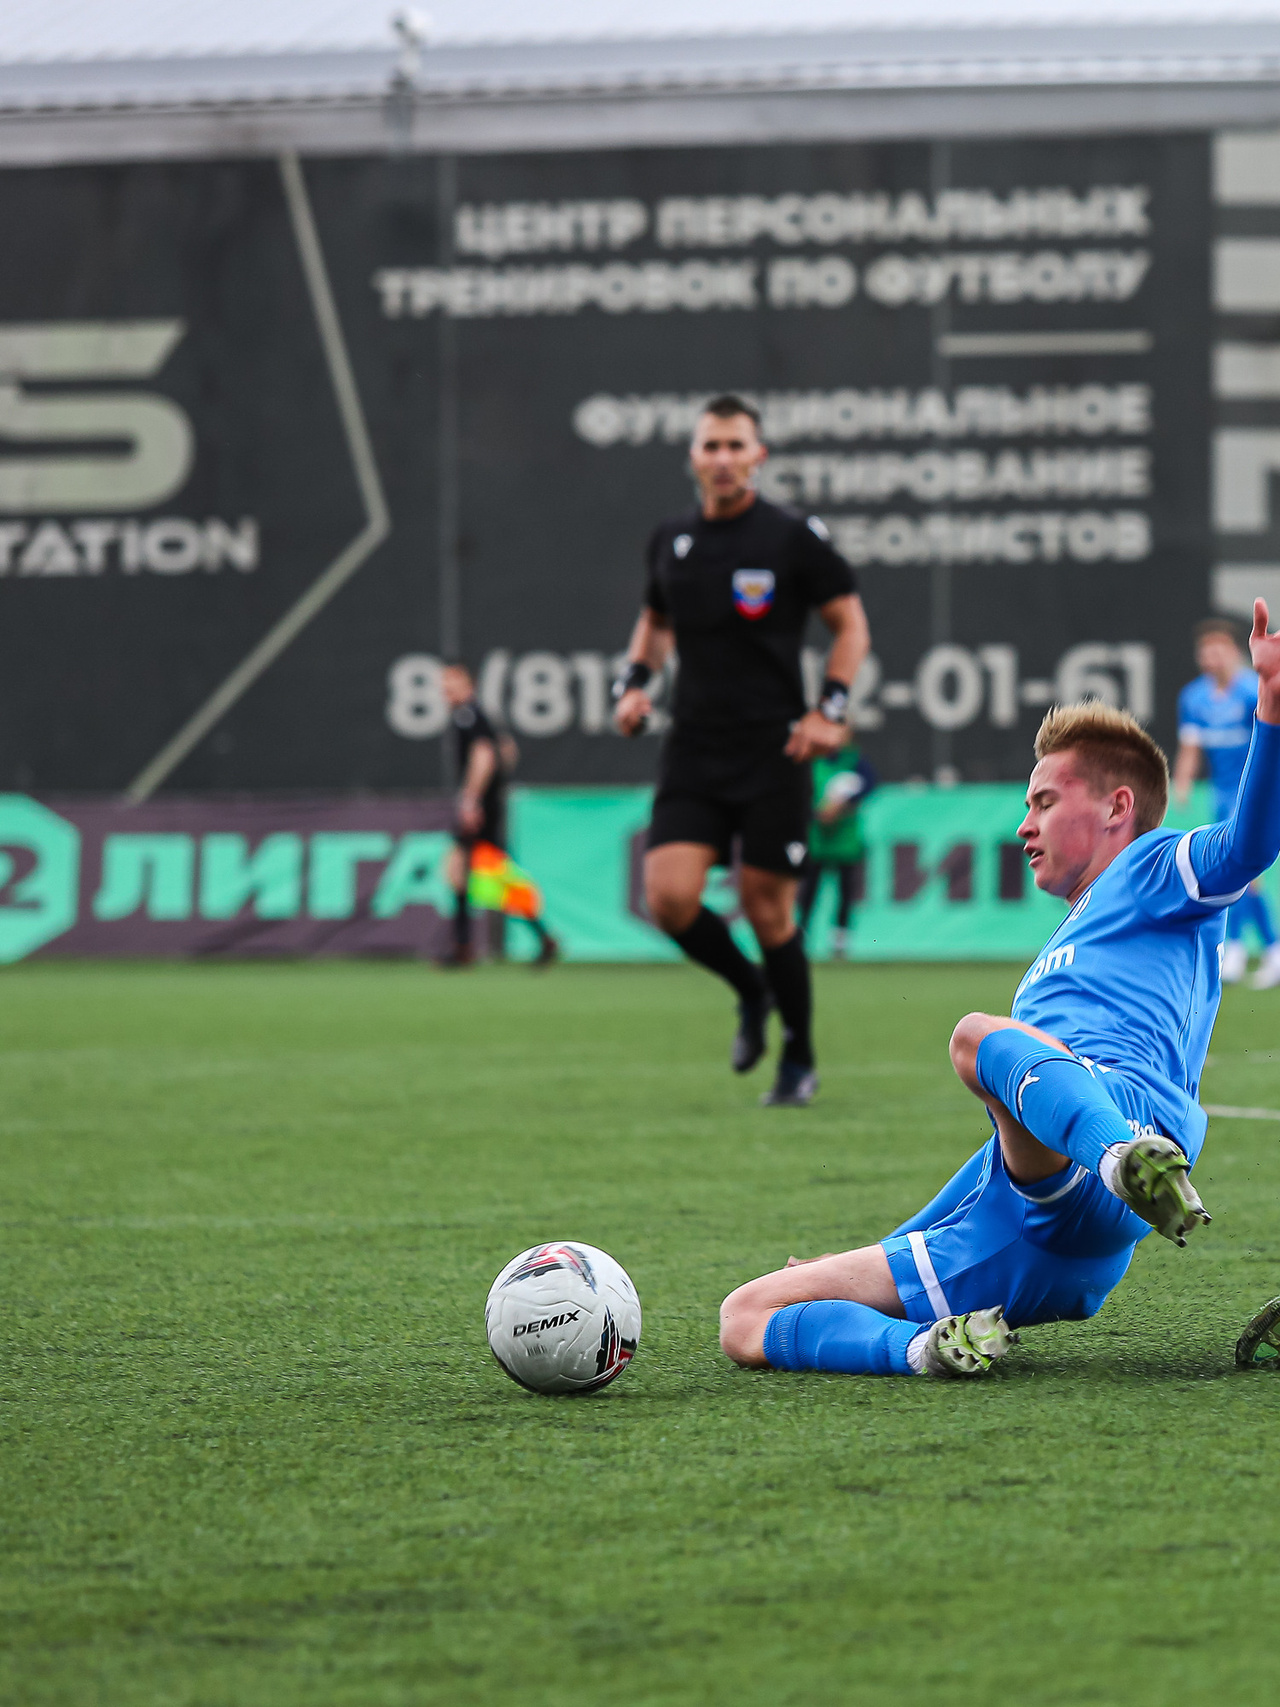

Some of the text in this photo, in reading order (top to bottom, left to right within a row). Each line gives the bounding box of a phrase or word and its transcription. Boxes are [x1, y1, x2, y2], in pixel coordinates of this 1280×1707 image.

[455, 186, 1151, 260] ЦЕНТР ПЕРСОНАЛЬНЫХ
[376, 247, 1152, 319] ТРЕНИРОВОК ПО ФУТБОЛУ
[756, 446, 1153, 502] СТИРОВАНИЕ
[0, 516, 259, 577] TATION
[825, 507, 1152, 567] БОЛИСТОВ
[386, 652, 449, 740] 8
[93, 831, 457, 921] ЛИГА
[512, 1309, 581, 1338] DEMIX
